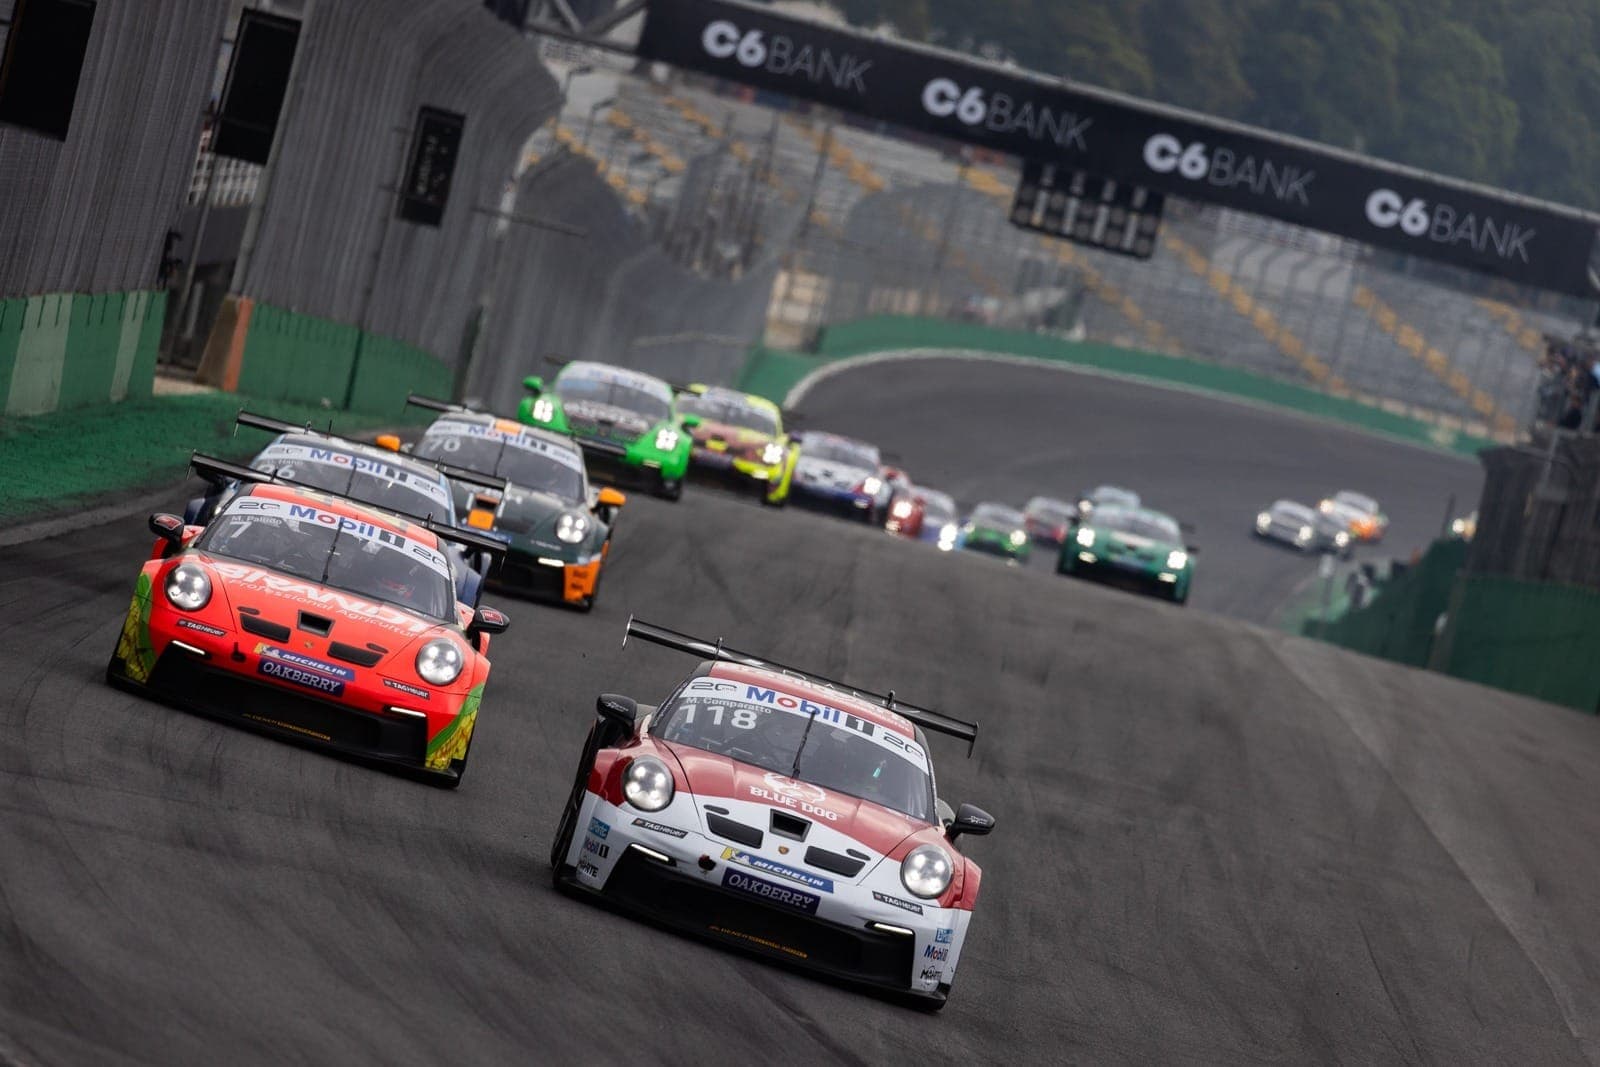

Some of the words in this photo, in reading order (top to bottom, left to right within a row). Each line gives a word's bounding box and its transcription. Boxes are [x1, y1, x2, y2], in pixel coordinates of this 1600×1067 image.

[428, 437, 461, 452] 70
[310, 448, 382, 474] Mobil
[229, 521, 253, 539] 7
[289, 504, 375, 537] Mobil
[263, 661, 341, 693] OAKBERRY
[282, 652, 347, 676] MICHELIN
[678, 704, 758, 731] 118
[703, 697, 772, 715] Comparatto
[745, 685, 841, 724] Mobil
[749, 785, 799, 808] BLUE
[800, 802, 839, 822] DOG
[753, 859, 825, 888] MICHELIN
[728, 873, 815, 909] OAKBERRY
